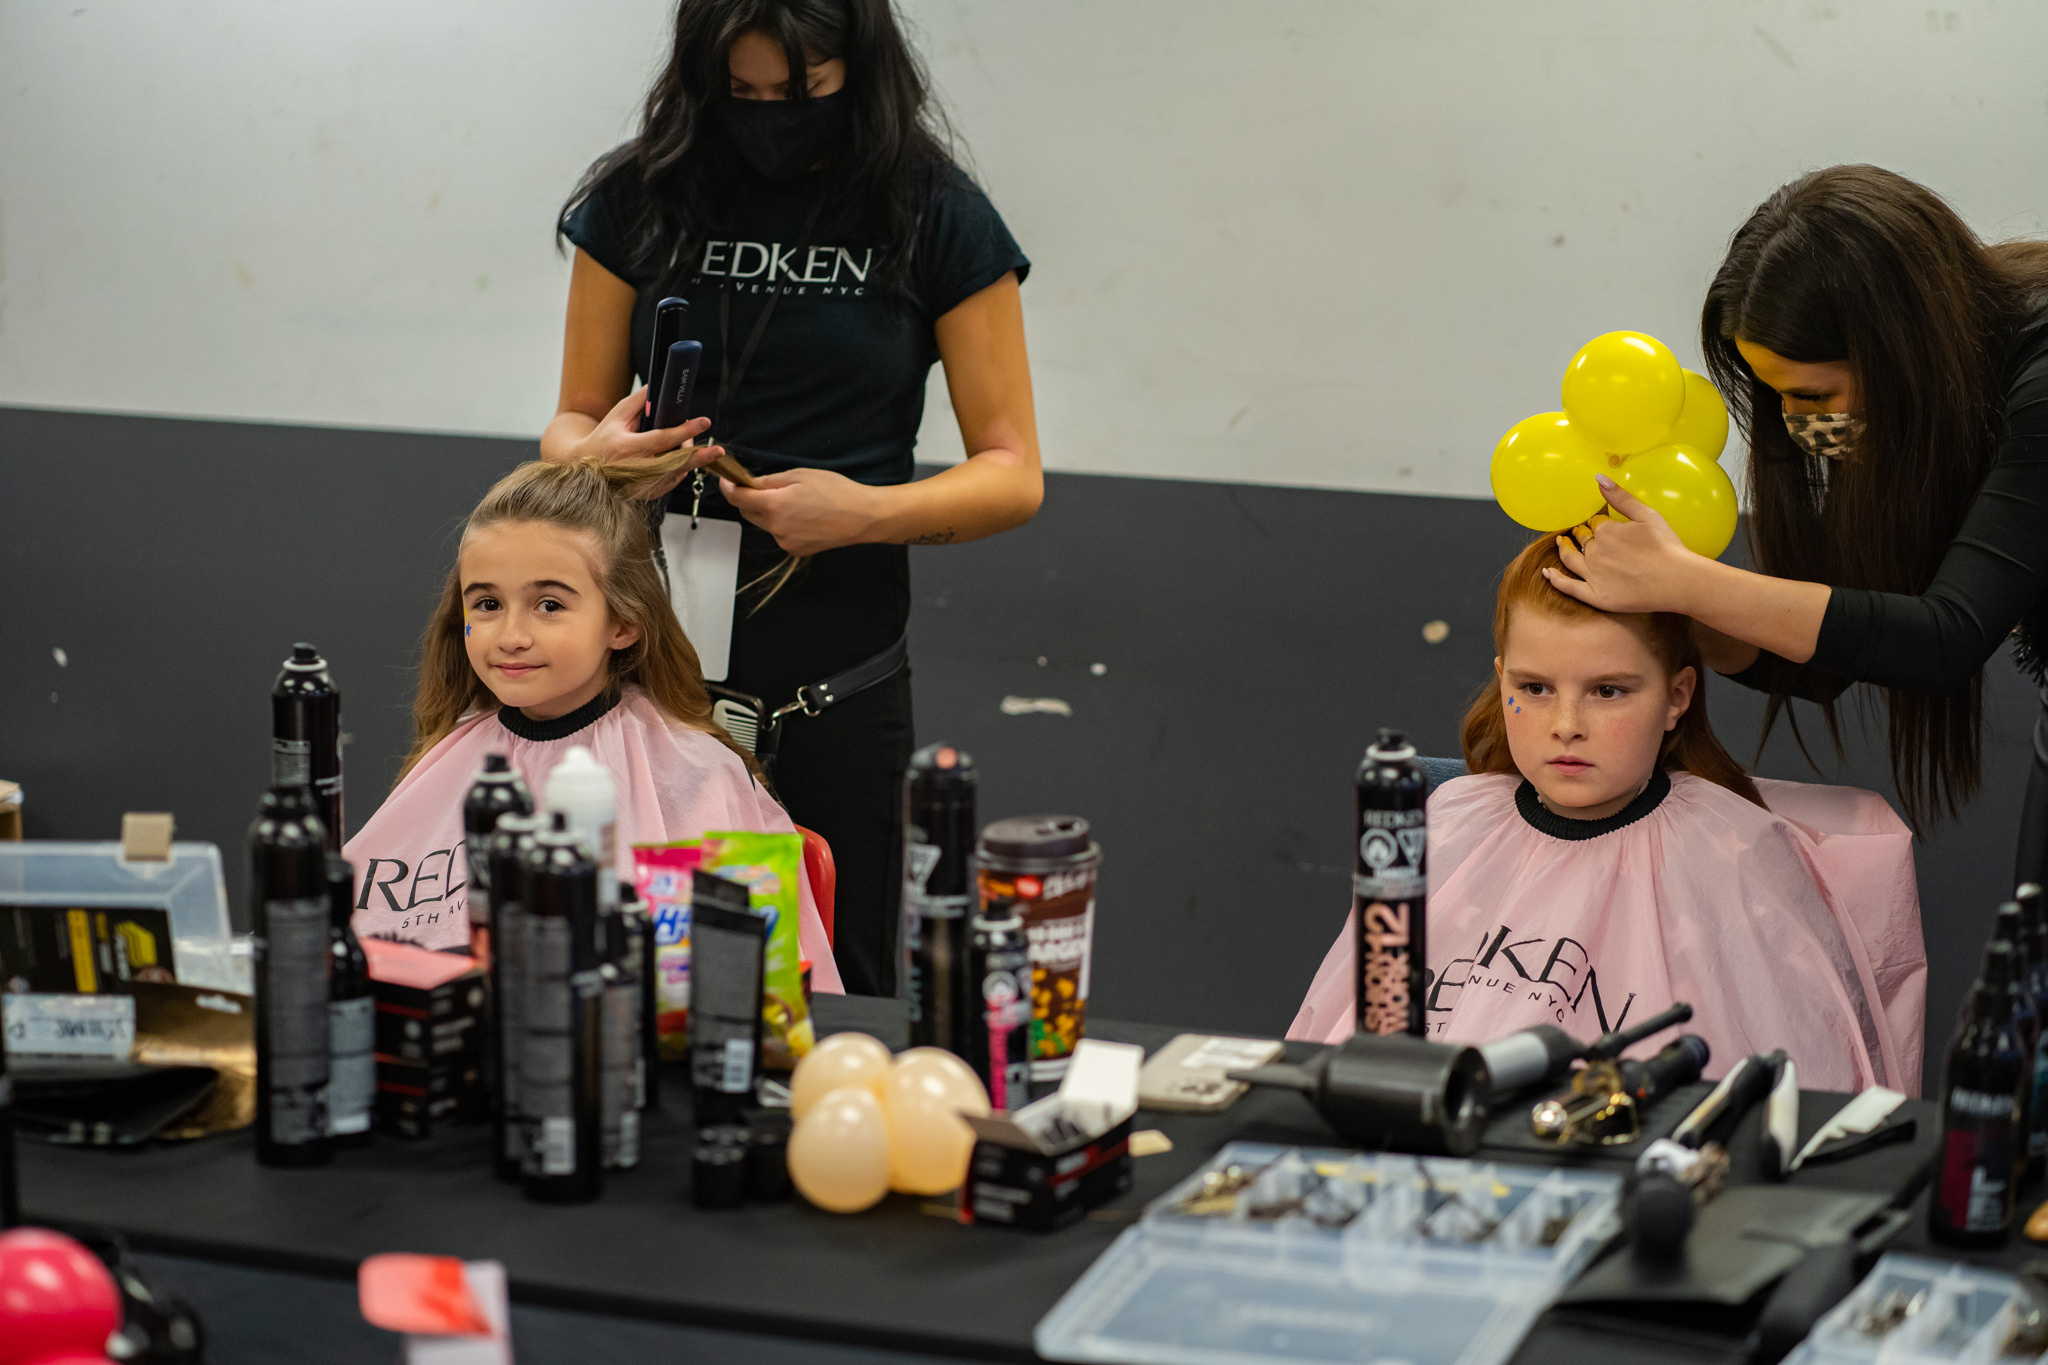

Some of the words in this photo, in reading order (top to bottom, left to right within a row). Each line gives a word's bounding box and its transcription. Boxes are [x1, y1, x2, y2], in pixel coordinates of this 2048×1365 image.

[669, 240, 873, 283] EDKEN
[719, 281, 806, 296] VENUE
[822, 286, 865, 297] NYC
[401, 912, 440, 929] 5TH
